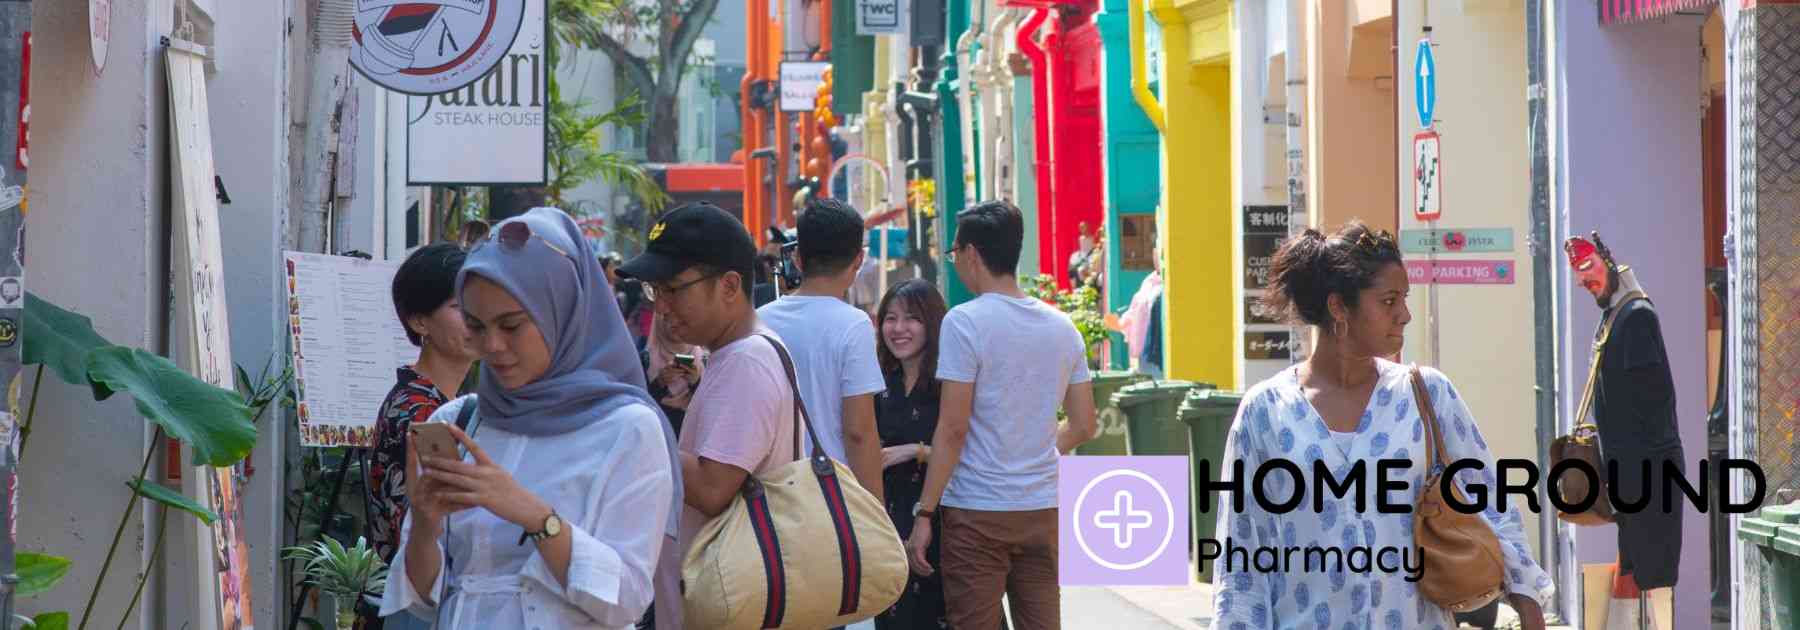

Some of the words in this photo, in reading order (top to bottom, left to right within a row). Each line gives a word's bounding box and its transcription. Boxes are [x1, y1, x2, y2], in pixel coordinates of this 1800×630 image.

[860, 3, 894, 15] TWC
[435, 112, 484, 126] STEAK
[488, 112, 542, 126] HOUSE
[1248, 212, 1289, 226] 客制化
[1408, 265, 1425, 278] NO
[1432, 266, 1489, 278] PARKING
